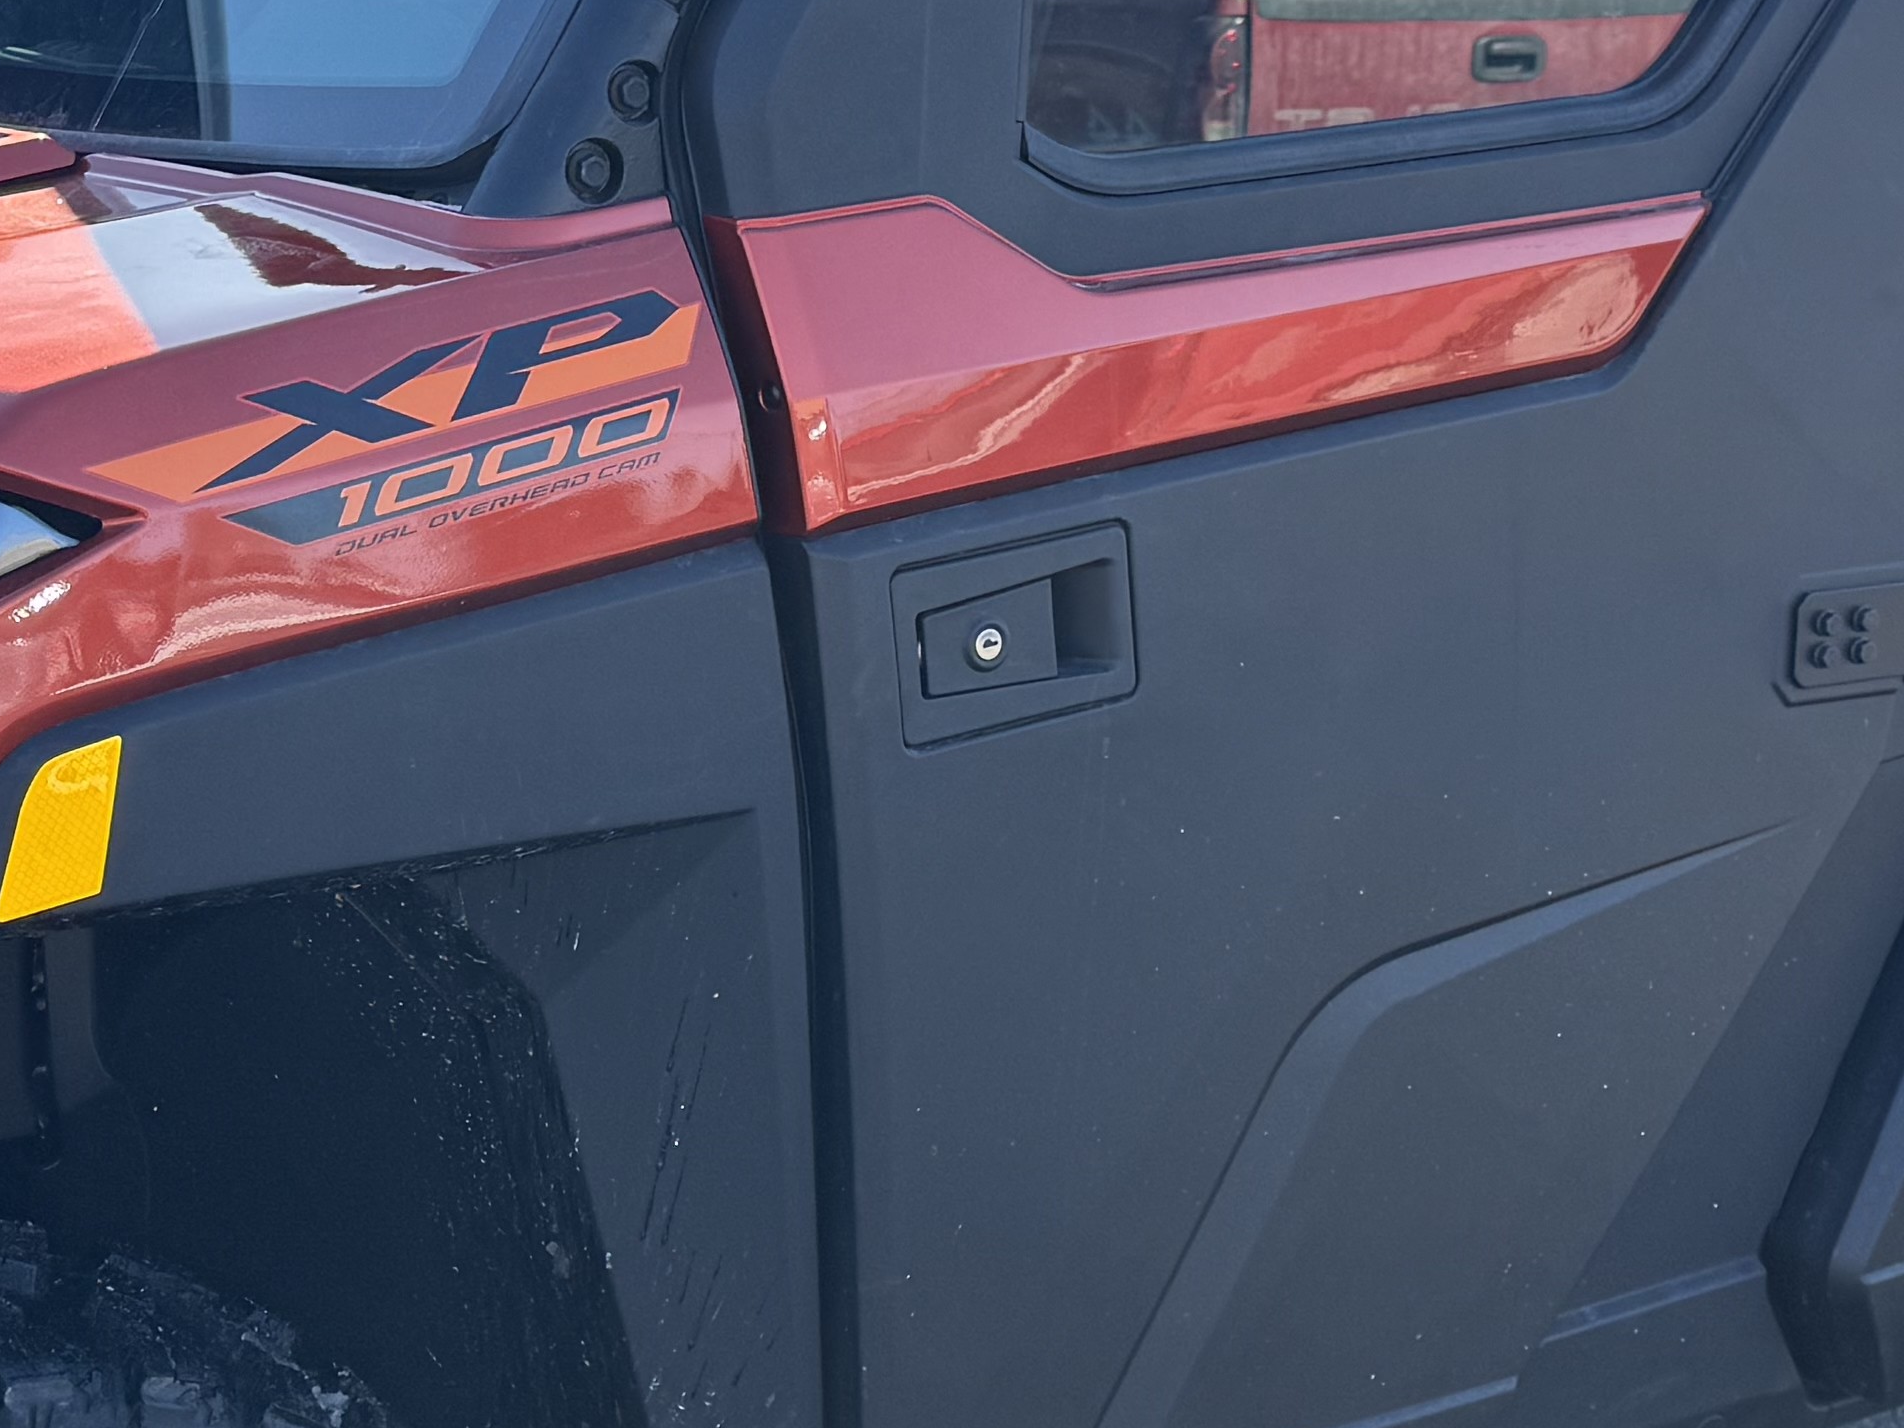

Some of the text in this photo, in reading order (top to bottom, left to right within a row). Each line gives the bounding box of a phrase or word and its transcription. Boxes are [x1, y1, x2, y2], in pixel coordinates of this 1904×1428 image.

[192, 289, 684, 493] XP
[334, 451, 663, 557] DUAL OVERHEAD CAM
[337, 398, 672, 528] 1000
